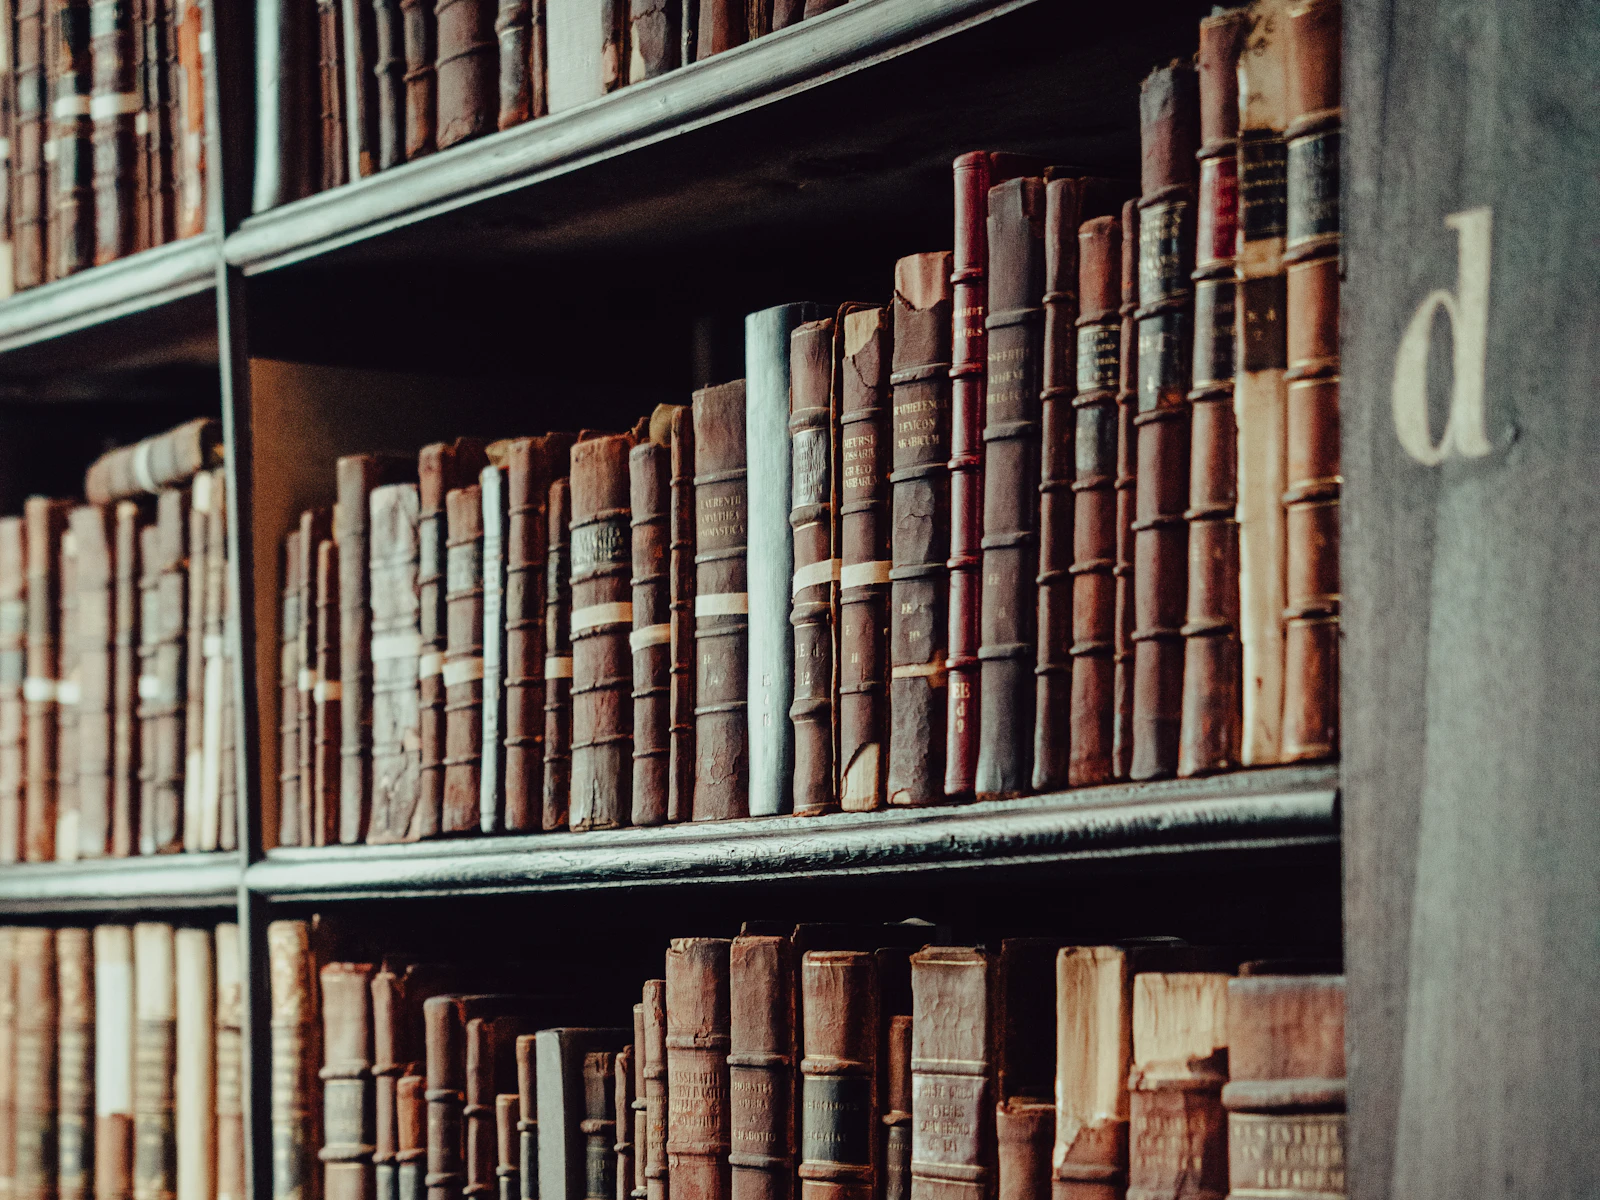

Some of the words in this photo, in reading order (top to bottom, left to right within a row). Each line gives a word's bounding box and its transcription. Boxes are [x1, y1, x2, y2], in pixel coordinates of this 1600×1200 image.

[1392, 206, 1493, 466] d
[950, 682, 971, 699] EE
[956, 700, 966, 717] d
[956, 718, 966, 734] 9
